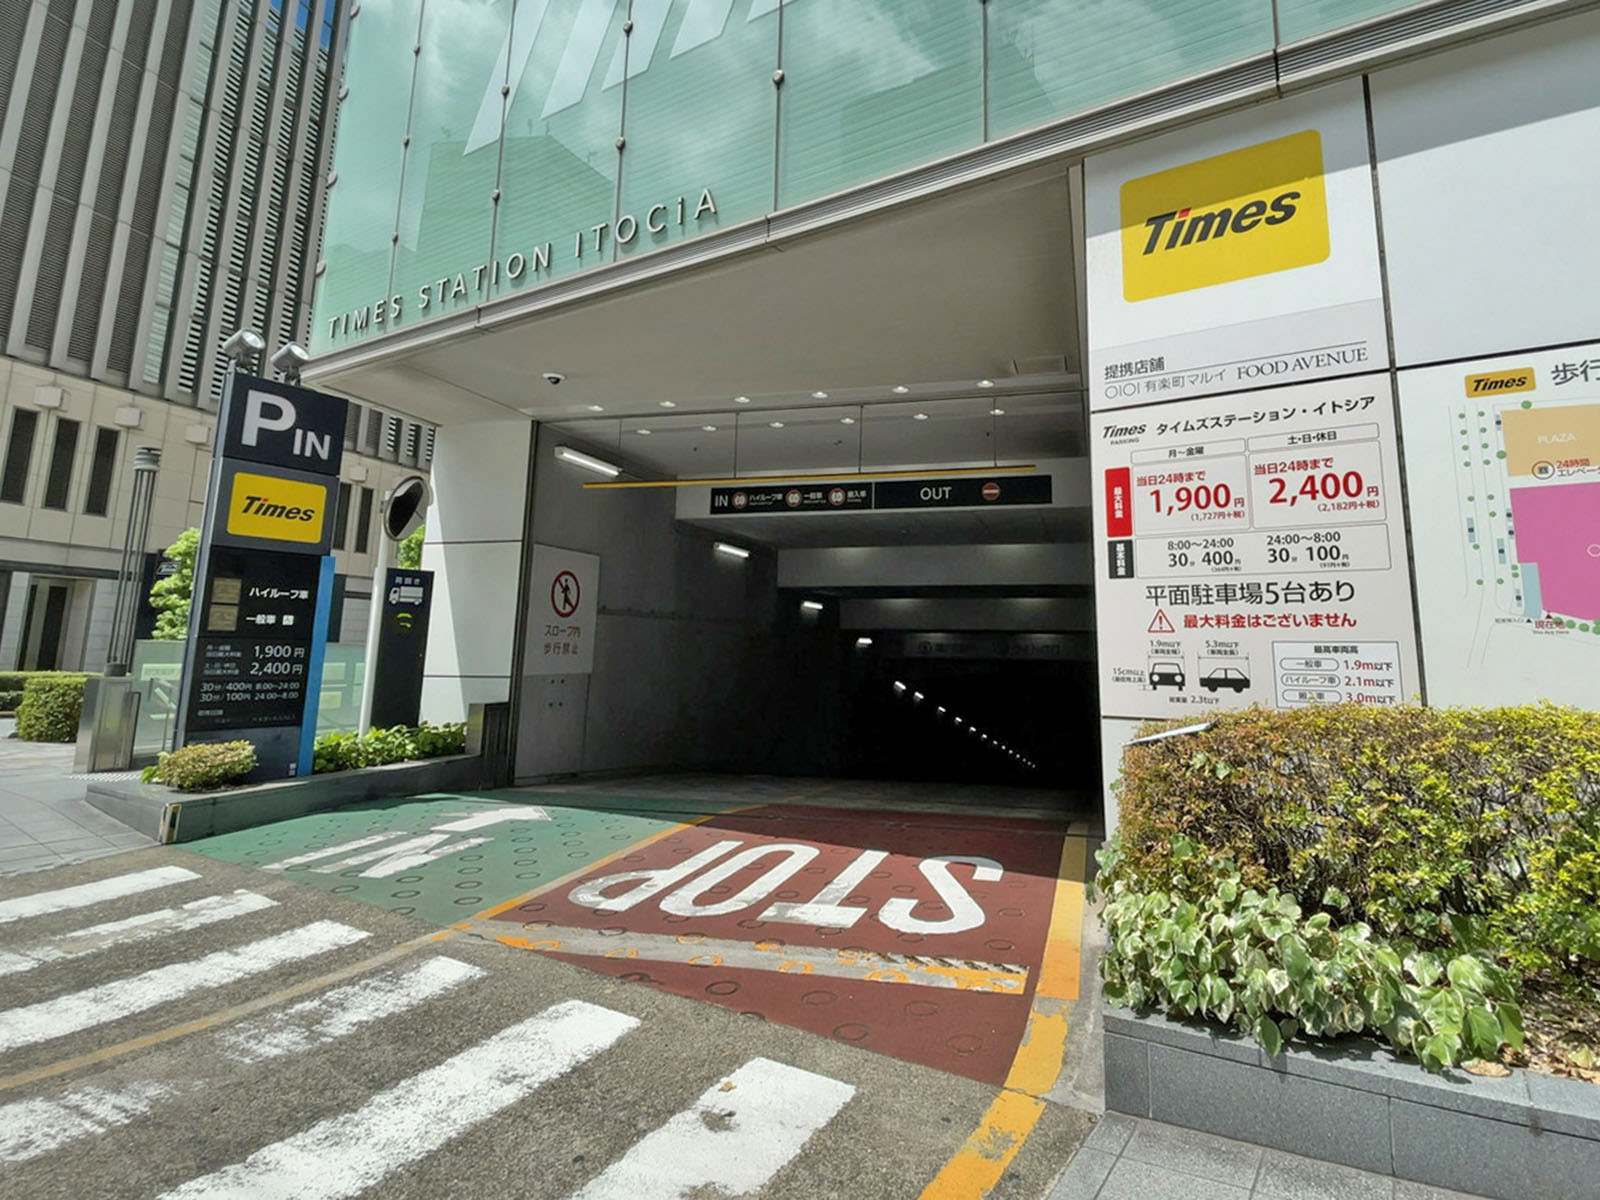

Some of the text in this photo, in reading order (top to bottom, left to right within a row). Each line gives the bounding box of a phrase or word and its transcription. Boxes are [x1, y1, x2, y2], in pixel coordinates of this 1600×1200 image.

[1142, 191, 1301, 256] Times
[327, 295, 402, 340] TIMES
[417, 243, 553, 309] STATION
[1104, 356, 1166, 379] 提携店舗
[1144, 368, 1226, 393] 有楽町マルイ
[1237, 359, 1289, 380] FOOD
[1291, 347, 1369, 371] AVENUE
[1471, 374, 1528, 393] Times
[241, 389, 331, 460] P IN
[1156, 396, 1376, 436] タイムズステーション・イトシア
[1102, 422, 1147, 440] Times
[1537, 432, 1577, 445] PLAZA
[1109, 437, 1140, 446] PARKING
[1253, 457, 1334, 476] 当日24時まで
[1558, 464, 1600, 477] エレベー
[1136, 470, 1206, 487] 当日24時まで
[715, 494, 729, 507] IN
[919, 486, 953, 501] OUT
[241, 495, 316, 522] Times
[248, 587, 310, 601] ハイルーフ車
[1145, 579, 1356, 608] 平面駐車場5台あり
[1183, 612, 1358, 629] 最大料金はございません
[544, 623, 581, 638] スロープ内
[543, 641, 579, 656] 歩行禁止
[1343, 658, 1393, 672] 1.9m以下
[1284, 675, 1395, 689] ハイルーフ車 2.1m以下
[567, 839, 1005, 935] STOP
